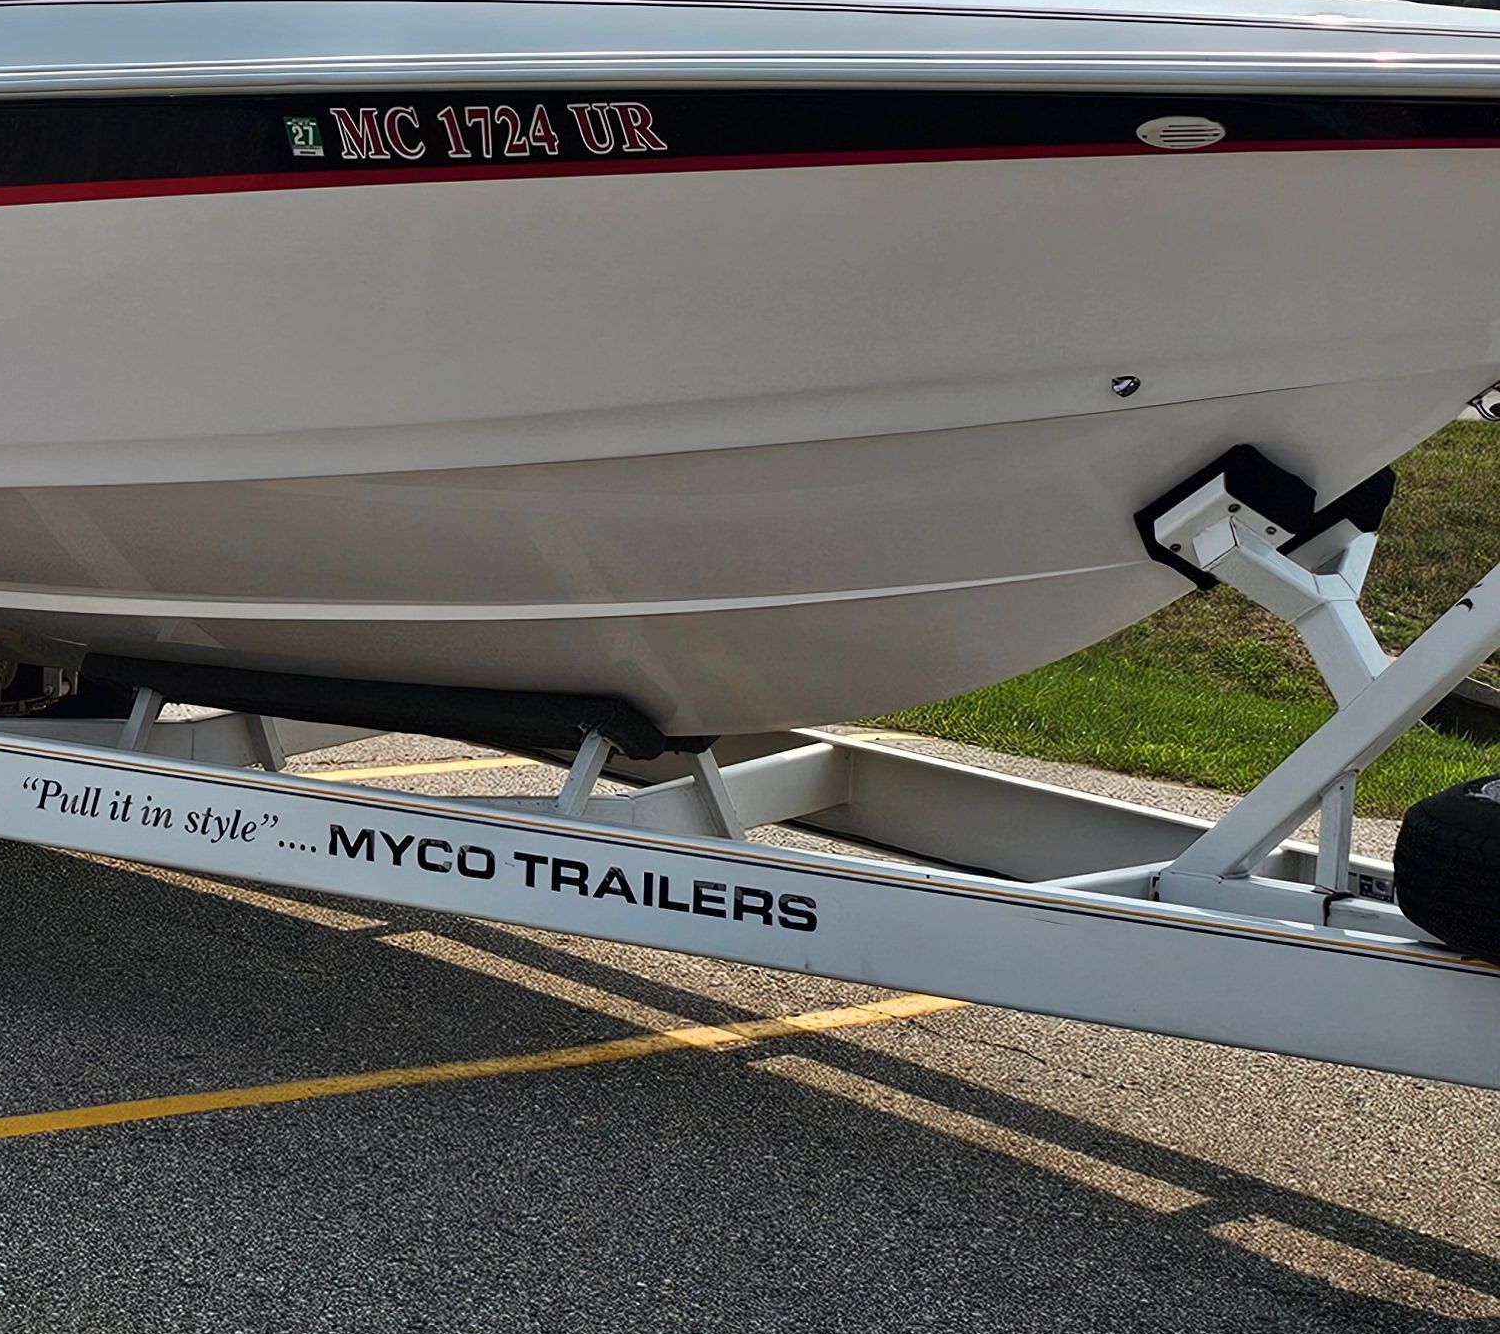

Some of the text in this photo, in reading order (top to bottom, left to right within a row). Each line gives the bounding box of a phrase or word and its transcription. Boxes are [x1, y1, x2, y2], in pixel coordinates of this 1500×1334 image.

[291, 125, 314, 145] 27
[330, 101, 668, 160] MC 1724 UR
[22, 776, 102, 819] “Pull
[109, 790, 133, 823] it
[141, 795, 173, 830] in
[328, 824, 496, 880] MYCO
[513, 851, 819, 933] TRAILERS
